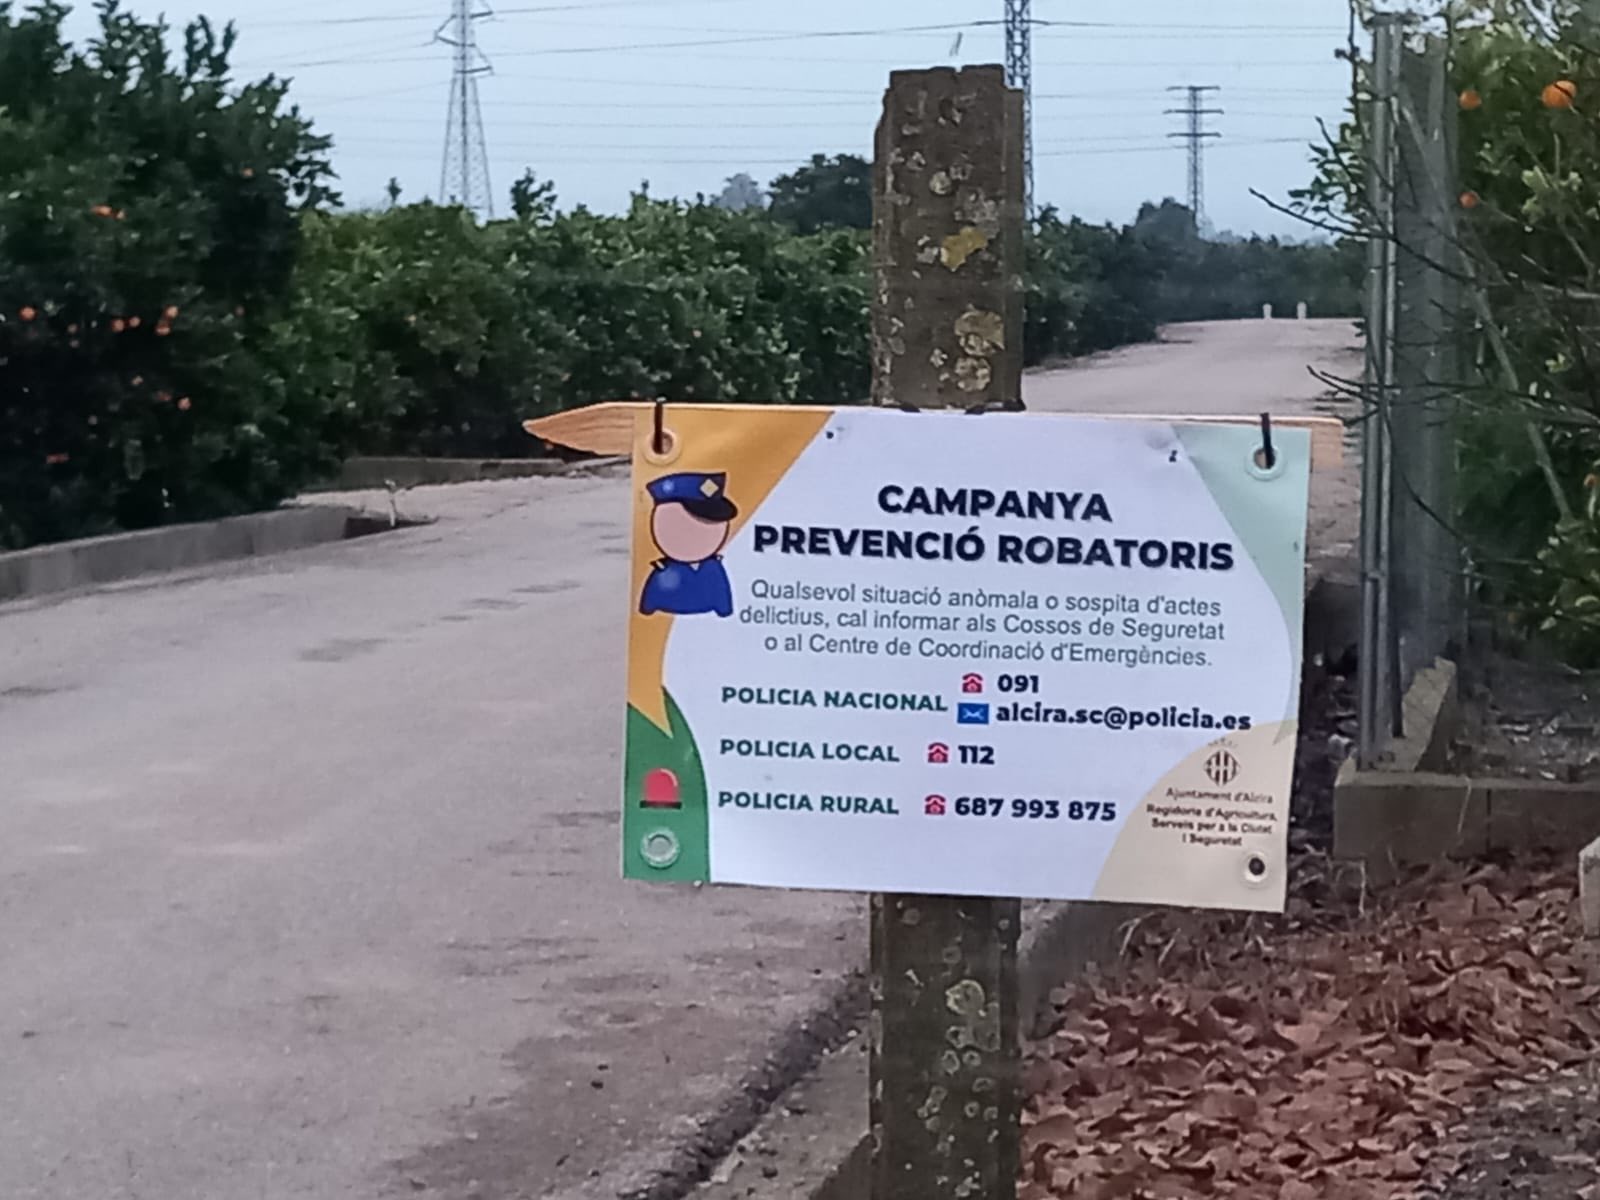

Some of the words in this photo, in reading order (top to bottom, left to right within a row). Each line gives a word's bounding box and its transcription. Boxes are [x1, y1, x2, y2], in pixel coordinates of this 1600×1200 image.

[877, 484, 1114, 523] CAMPANYA
[753, 524, 986, 562] PREVENCIÓ
[997, 533, 1235, 571] ROBATORIS
[751, 579, 856, 603] Qualsevol
[862, 585, 942, 606] situació
[948, 588, 1039, 610] anòmala
[1045, 596, 1059, 610] o
[1065, 593, 1140, 617] sospita
[1147, 595, 1222, 617] d'actes
[739, 606, 831, 629] delictius,
[837, 608, 868, 628] cal
[874, 609, 961, 632] informar
[966, 614, 997, 633] als
[1003, 614, 1082, 636] Cossos
[1088, 616, 1115, 636] de
[1121, 617, 1225, 643] Seguretat
[764, 637, 778, 651] o
[784, 633, 801, 651] al
[808, 633, 879, 656] Centre
[885, 635, 912, 656] de
[918, 637, 1044, 661] Coordinació
[1051, 641, 1213, 669] d'Emergències.
[996, 673, 1040, 694] 091
[721, 685, 818, 708] POLICIA
[823, 690, 949, 712] NACIONAL
[995, 701, 1252, 732] alcira.sc@policia.es
[719, 738, 816, 760] POLICIA
[821, 742, 900, 764] LOCAL
[957, 745, 996, 765] 112
[717, 790, 815, 813] POLICIA
[819, 794, 900, 815] RURAL
[1166, 787, 1232, 802] Ajuntament
[954, 796, 1005, 817] 687
[1010, 798, 1061, 819] 993
[1067, 800, 1117, 822] 875
[1197, 822, 1216, 832] per
